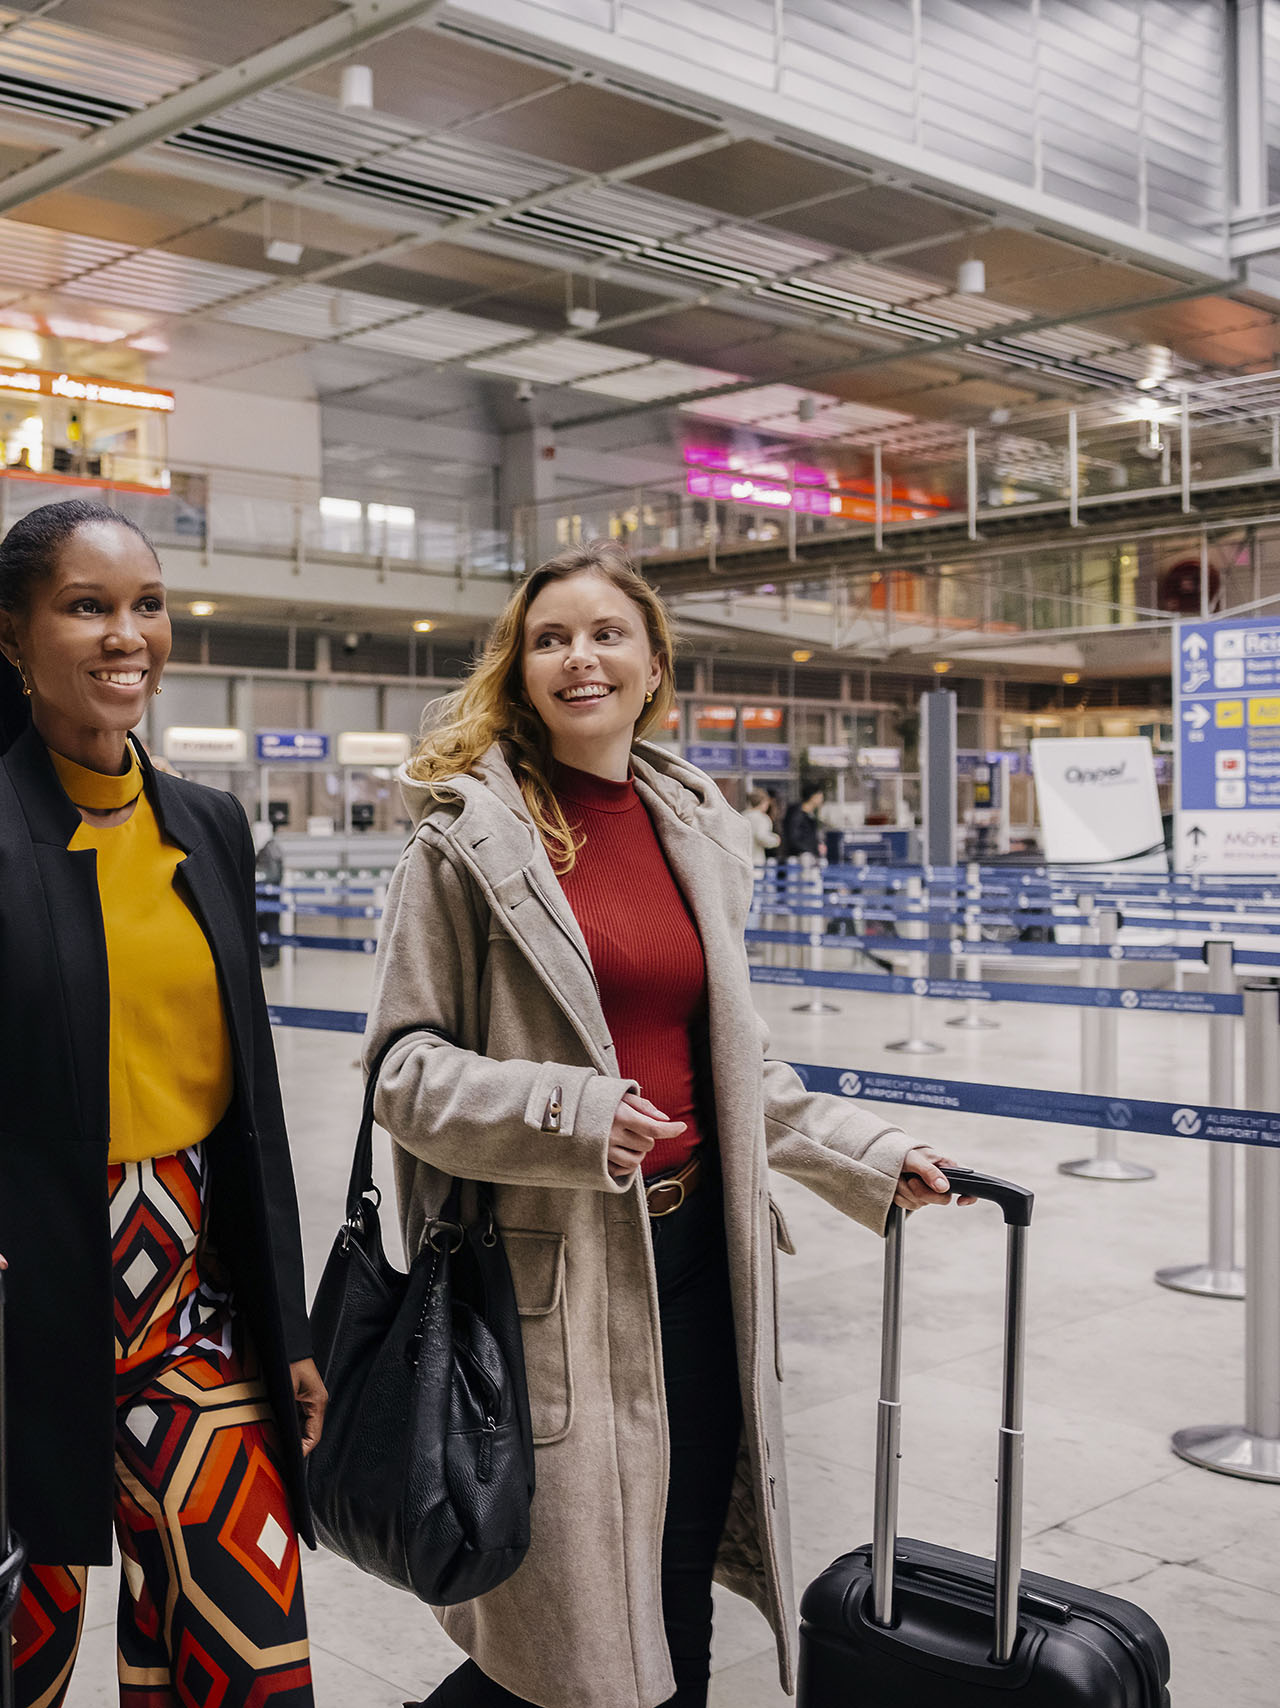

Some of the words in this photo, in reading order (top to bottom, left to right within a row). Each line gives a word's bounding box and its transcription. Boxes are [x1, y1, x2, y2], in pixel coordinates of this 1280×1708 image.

[863, 1078, 910, 1090] ALBRECHT
[863, 1087, 904, 1100] AIRPORT
[1205, 1114, 1268, 1129] ALBRECHT
[1205, 1126, 1259, 1140] AIRPORT
